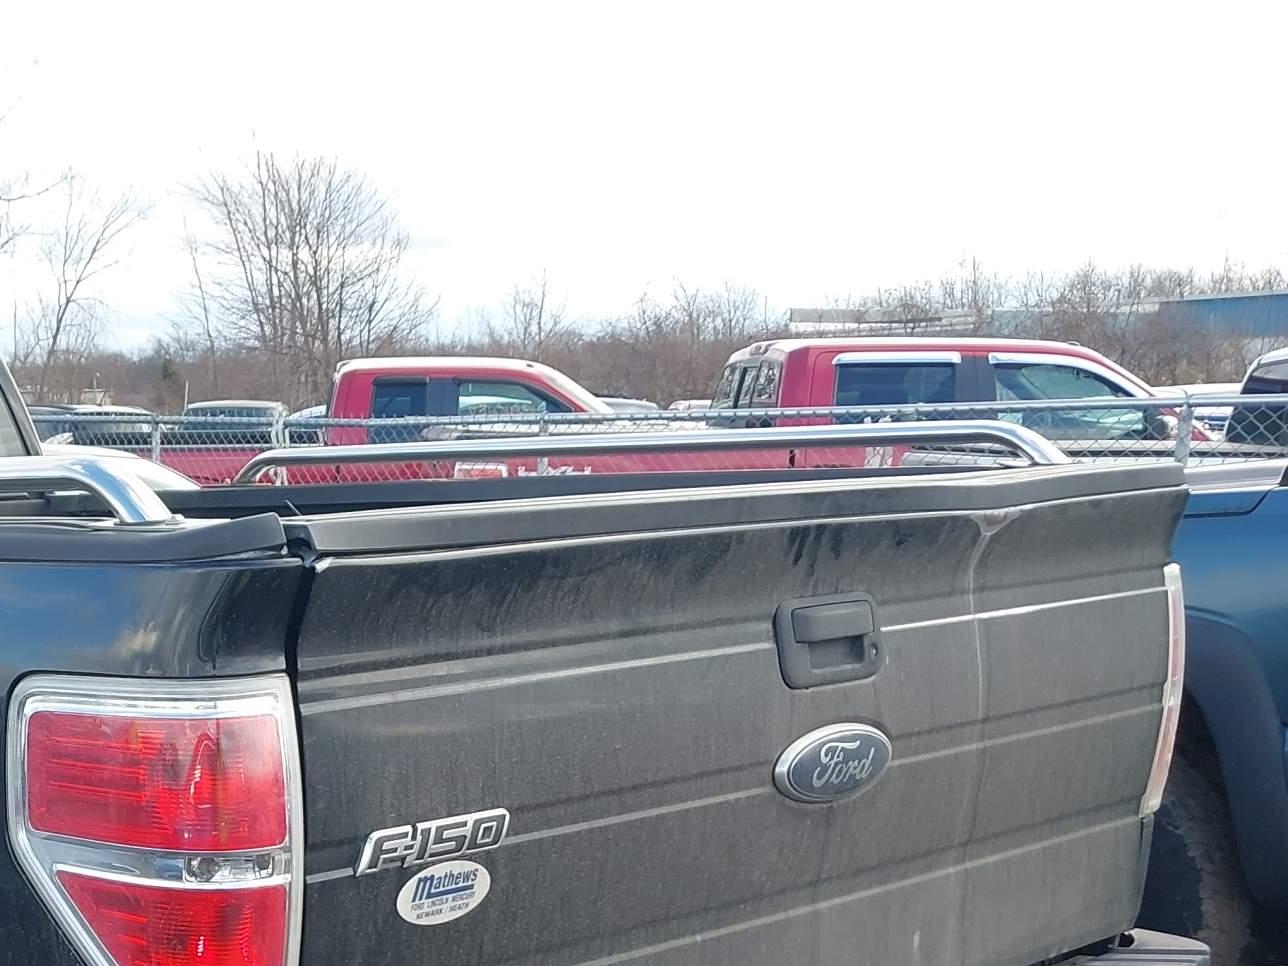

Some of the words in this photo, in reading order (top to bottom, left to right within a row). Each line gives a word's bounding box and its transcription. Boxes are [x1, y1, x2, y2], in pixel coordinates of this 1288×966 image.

[812, 740, 876, 788] Ford
[355, 807, 510, 877] F-150
[416, 908, 443, 920] NEWARK
